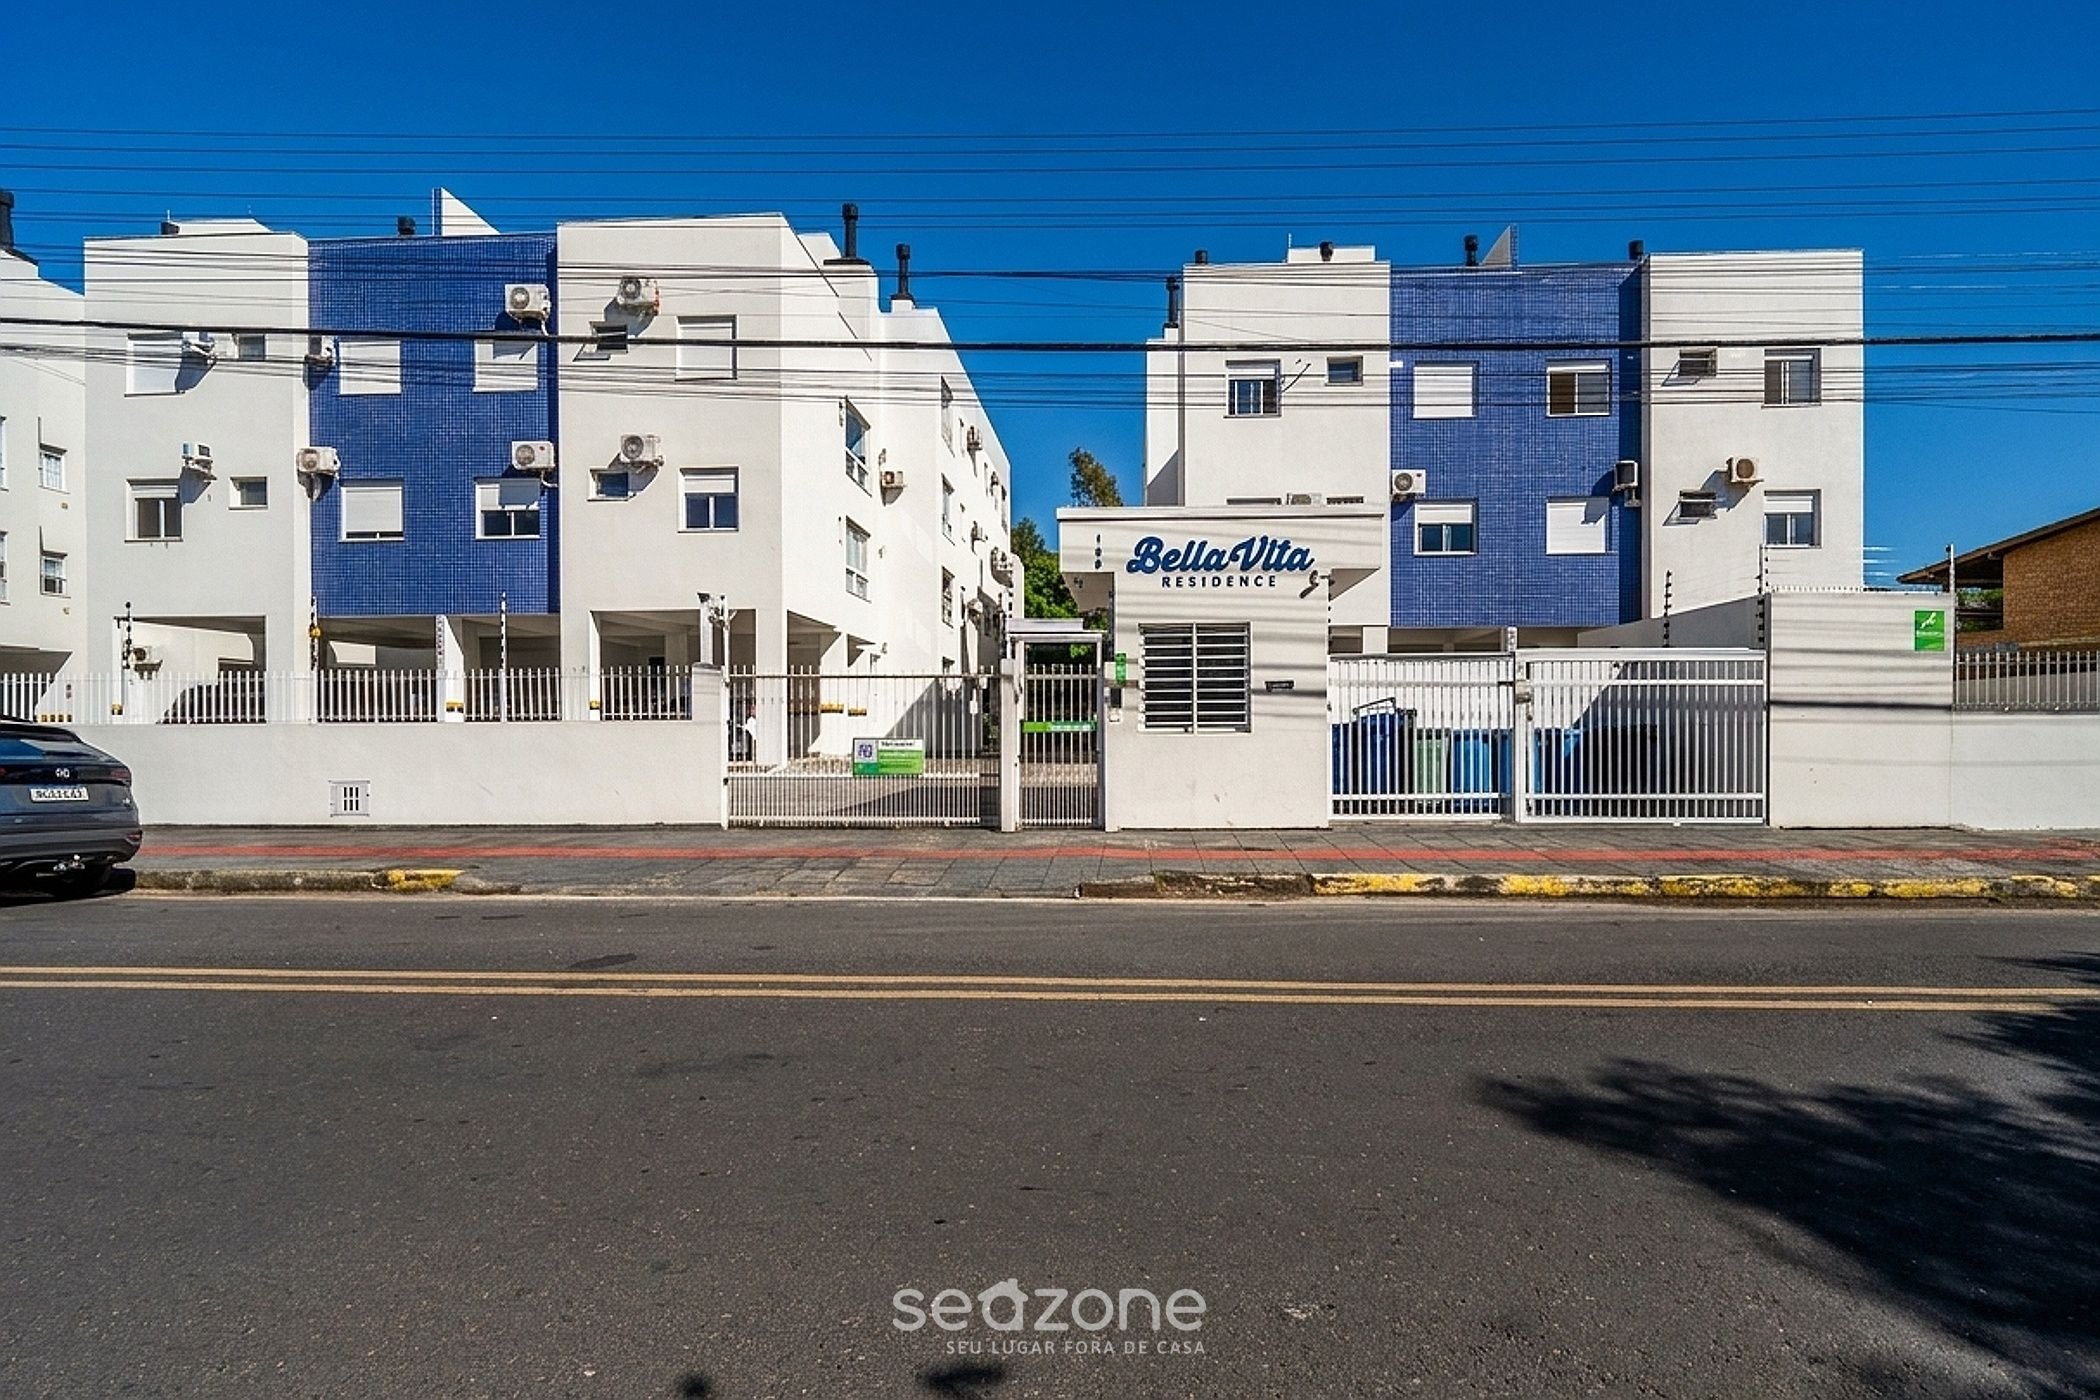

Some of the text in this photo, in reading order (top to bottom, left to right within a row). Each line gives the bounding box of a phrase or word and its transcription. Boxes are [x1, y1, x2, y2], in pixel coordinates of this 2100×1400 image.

[1126, 536, 1314, 573] Bella Vita
[1161, 576, 1276, 588] RESIDENCE
